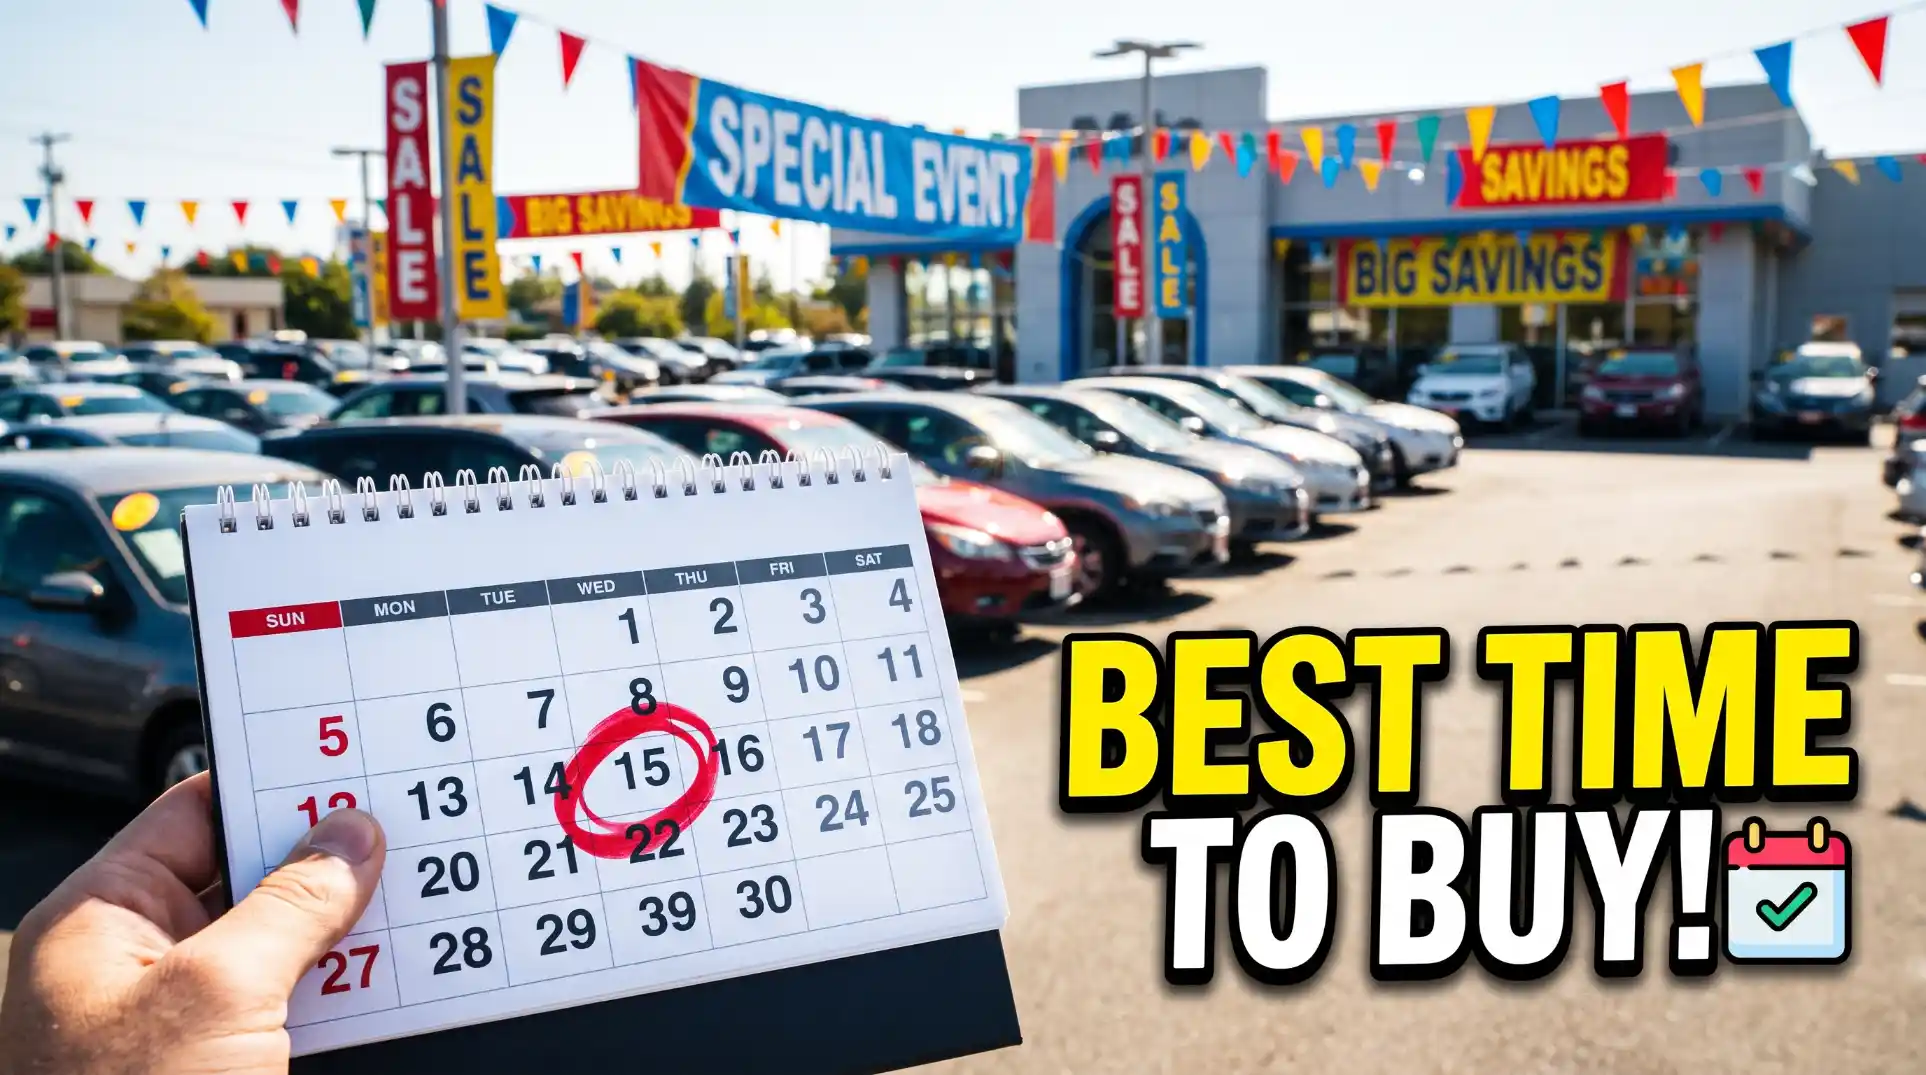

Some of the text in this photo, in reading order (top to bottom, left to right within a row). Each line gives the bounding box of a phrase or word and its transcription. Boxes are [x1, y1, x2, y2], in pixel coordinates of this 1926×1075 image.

[392, 77, 427, 303] SALE
[457, 75, 491, 300] SALE
[526, 195, 572, 236] BIG
[708, 96, 1020, 229] SPECIAL EVENT
[1481, 144, 1629, 203] SAVINGS
[1117, 184, 1140, 309] SALE
[1160, 182, 1181, 308] SALE
[1355, 245, 1605, 296] BIG SAVINGS
[265, 552, 883, 629] SUN MON TUE WED THU FRI SAT
[618, 578, 913, 645] 1 2 3 4
[318, 644, 924, 757] 5 6 7 8 9 10 11
[407, 775, 468, 821] 13
[513, 761, 573, 806] 14
[614, 746, 671, 791] 15
[712, 734, 765, 776] 16
[802, 721, 852, 762] 17
[891, 709, 942, 749] 18
[417, 775, 956, 899] 20 21 22 23 24 25
[316, 874, 793, 996] 27 28 29 39 30
